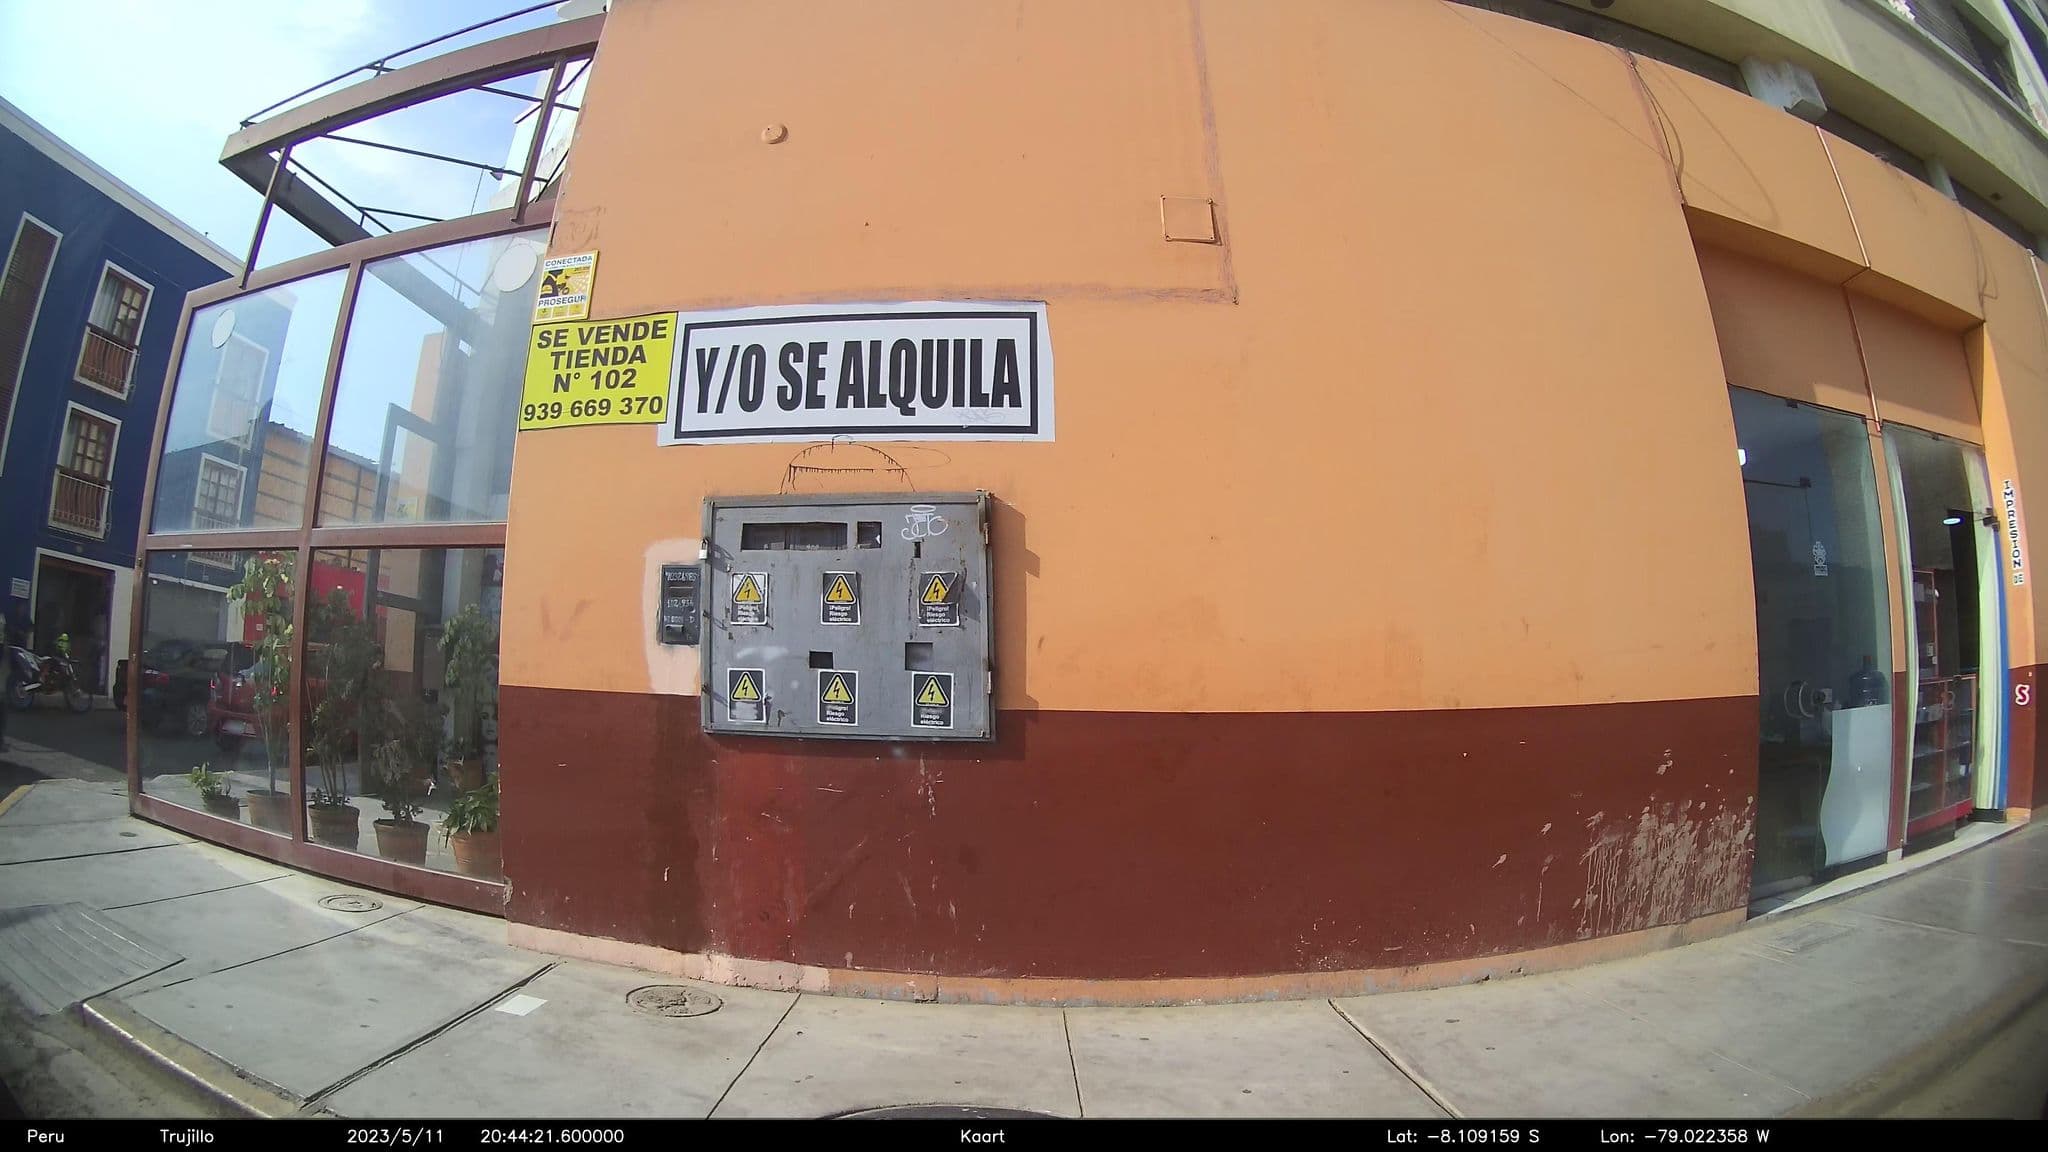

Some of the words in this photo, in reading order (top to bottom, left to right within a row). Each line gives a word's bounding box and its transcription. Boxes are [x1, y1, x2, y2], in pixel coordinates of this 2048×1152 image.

[545, 256, 592, 267] CONECTADA
[538, 295, 587, 306] PROSEGUR
[537, 328, 569, 349] SE
[578, 319, 668, 346] VENDE
[550, 345, 647, 370] TIENDA
[590, 368, 637, 390] 102
[695, 343, 766, 414] Y/O
[777, 342, 828, 412] SE
[836, 338, 1022, 416] ALQUILA
[523, 401, 562, 421] 939
[570, 398, 611, 417] 669
[619, 396, 663, 415] 370
[2004, 480, 2022, 568] IMPRESION
[2015, 684, 2030, 705] S
